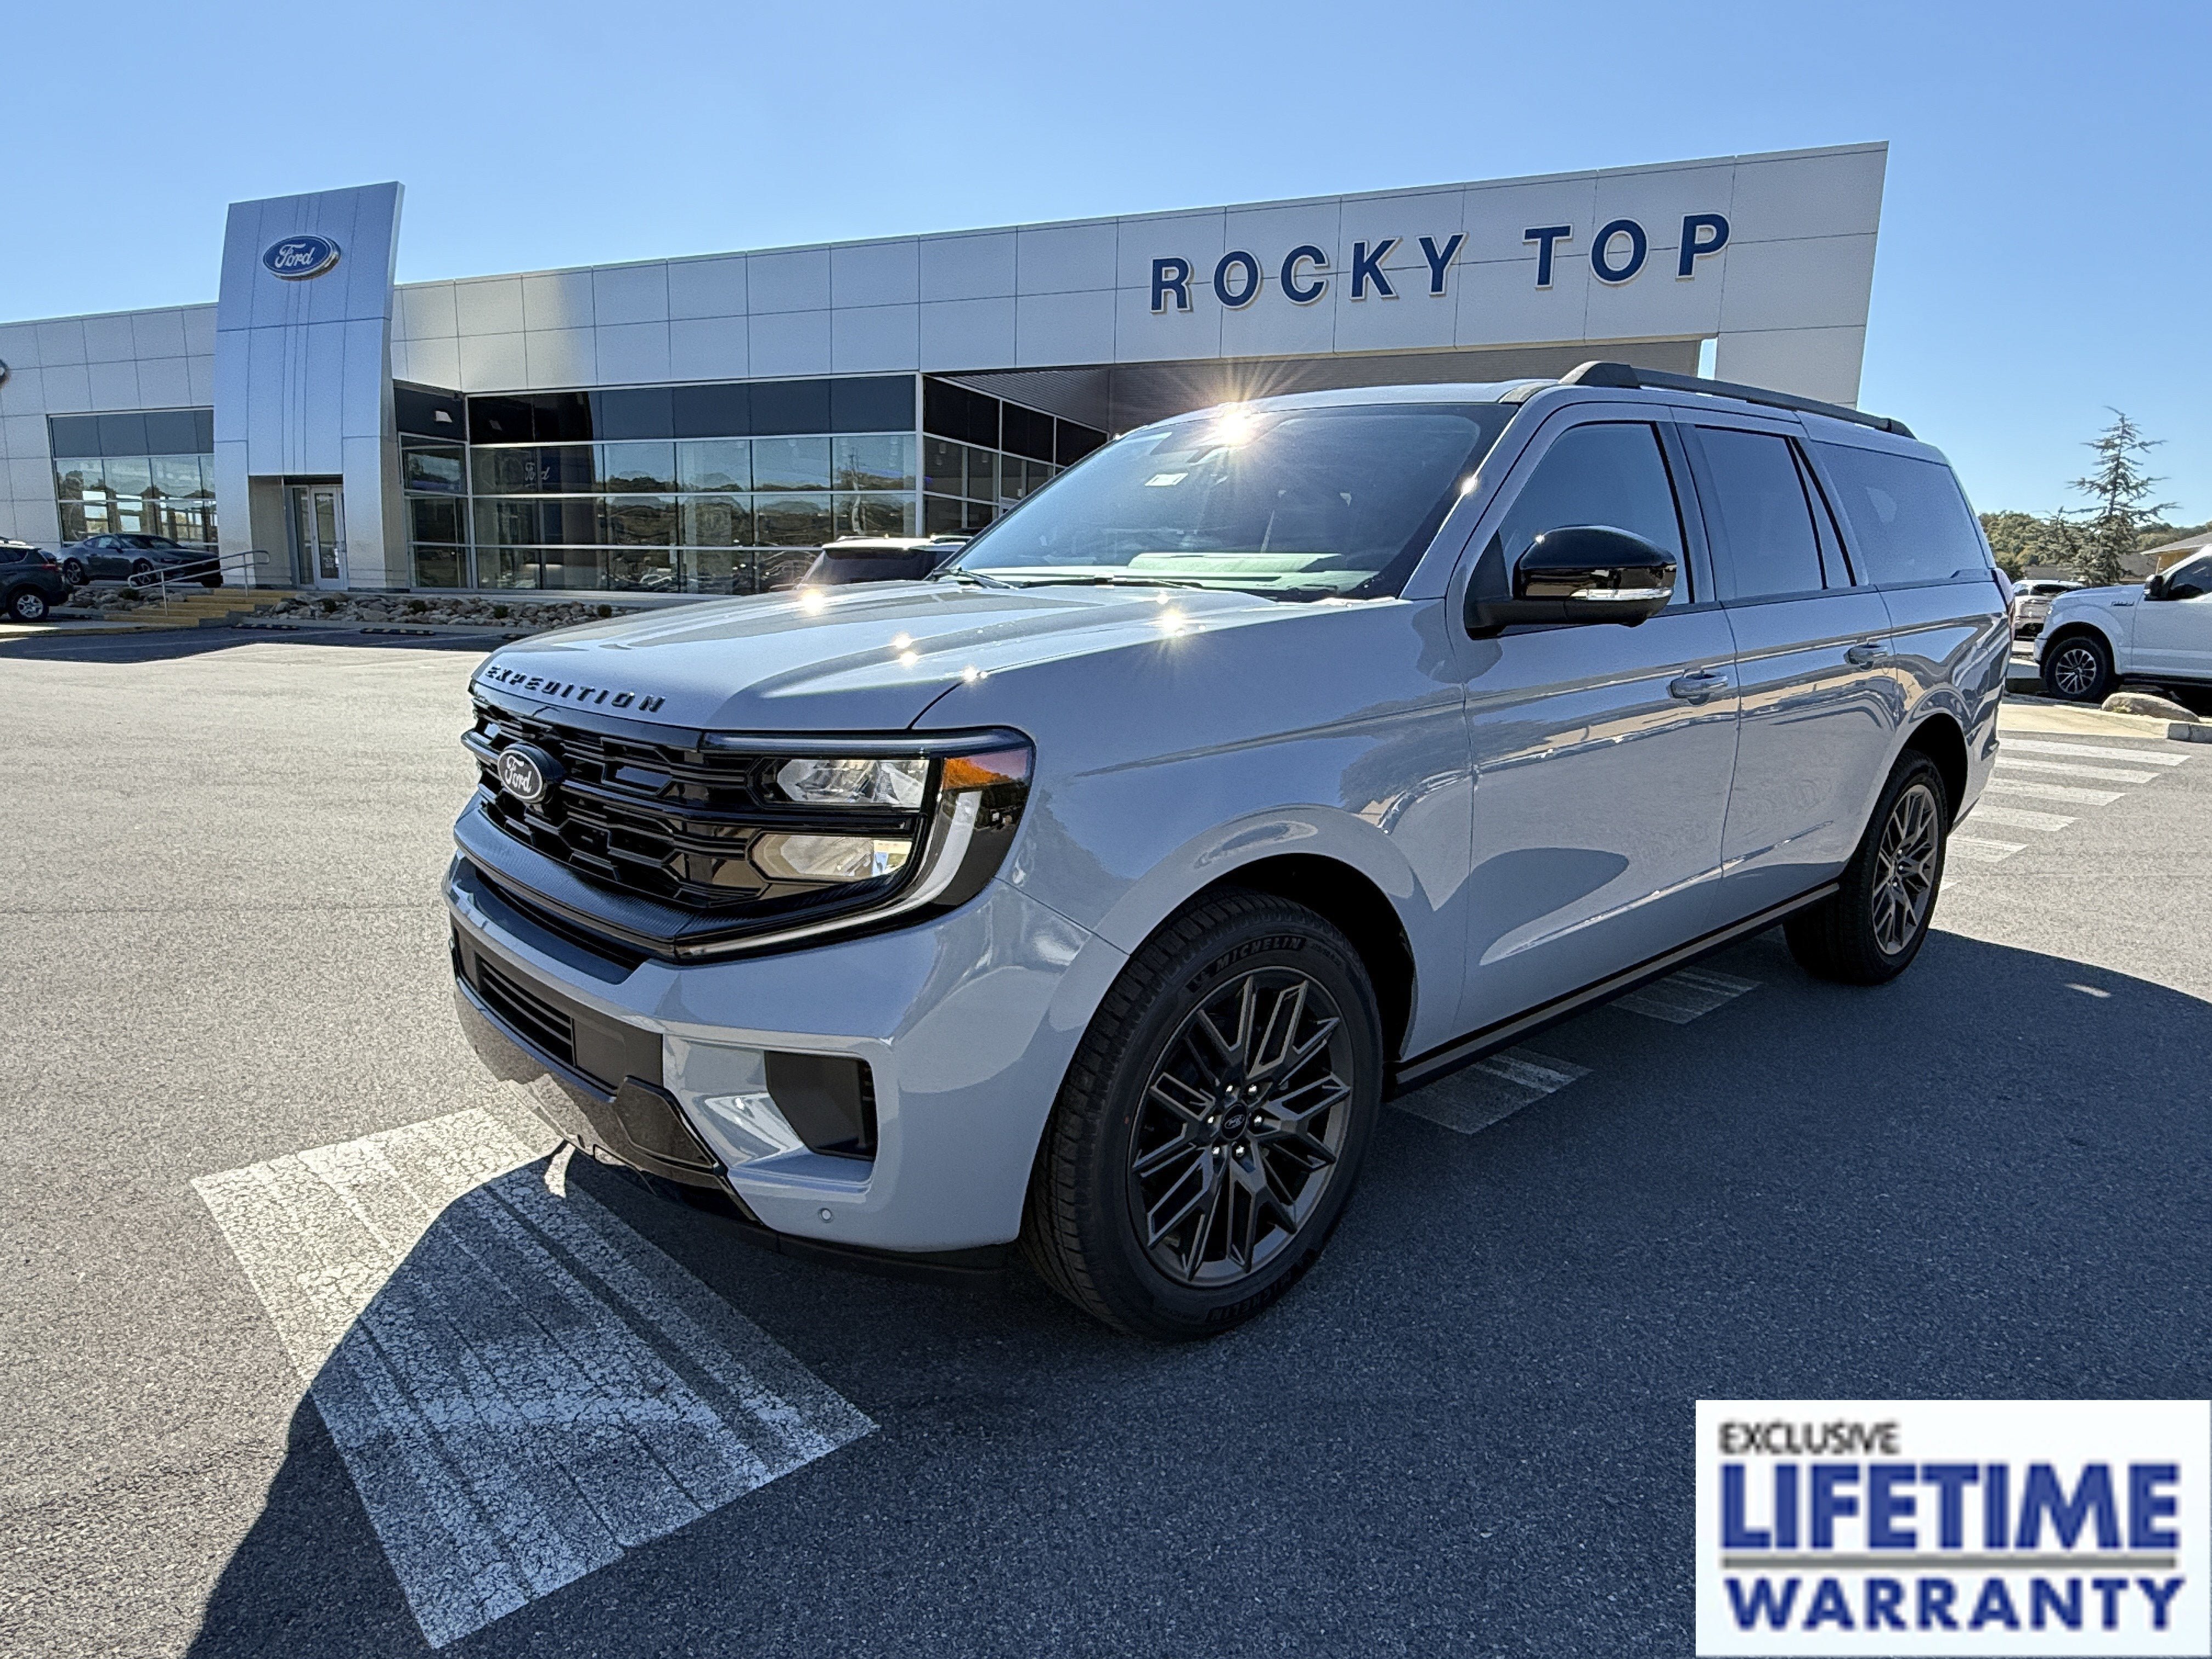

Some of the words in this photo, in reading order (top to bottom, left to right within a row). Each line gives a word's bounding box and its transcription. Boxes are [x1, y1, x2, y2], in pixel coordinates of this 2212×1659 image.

[275, 243, 315, 268] Ford
[1150, 232, 1467, 313] ROCKY
[1523, 212, 1730, 289] TOP
[525, 462, 550, 481] Fod
[485, 664, 666, 713] EXPEDITION
[505, 755, 533, 793] Ford
[1215, 936, 1304, 973] MICHELIN
